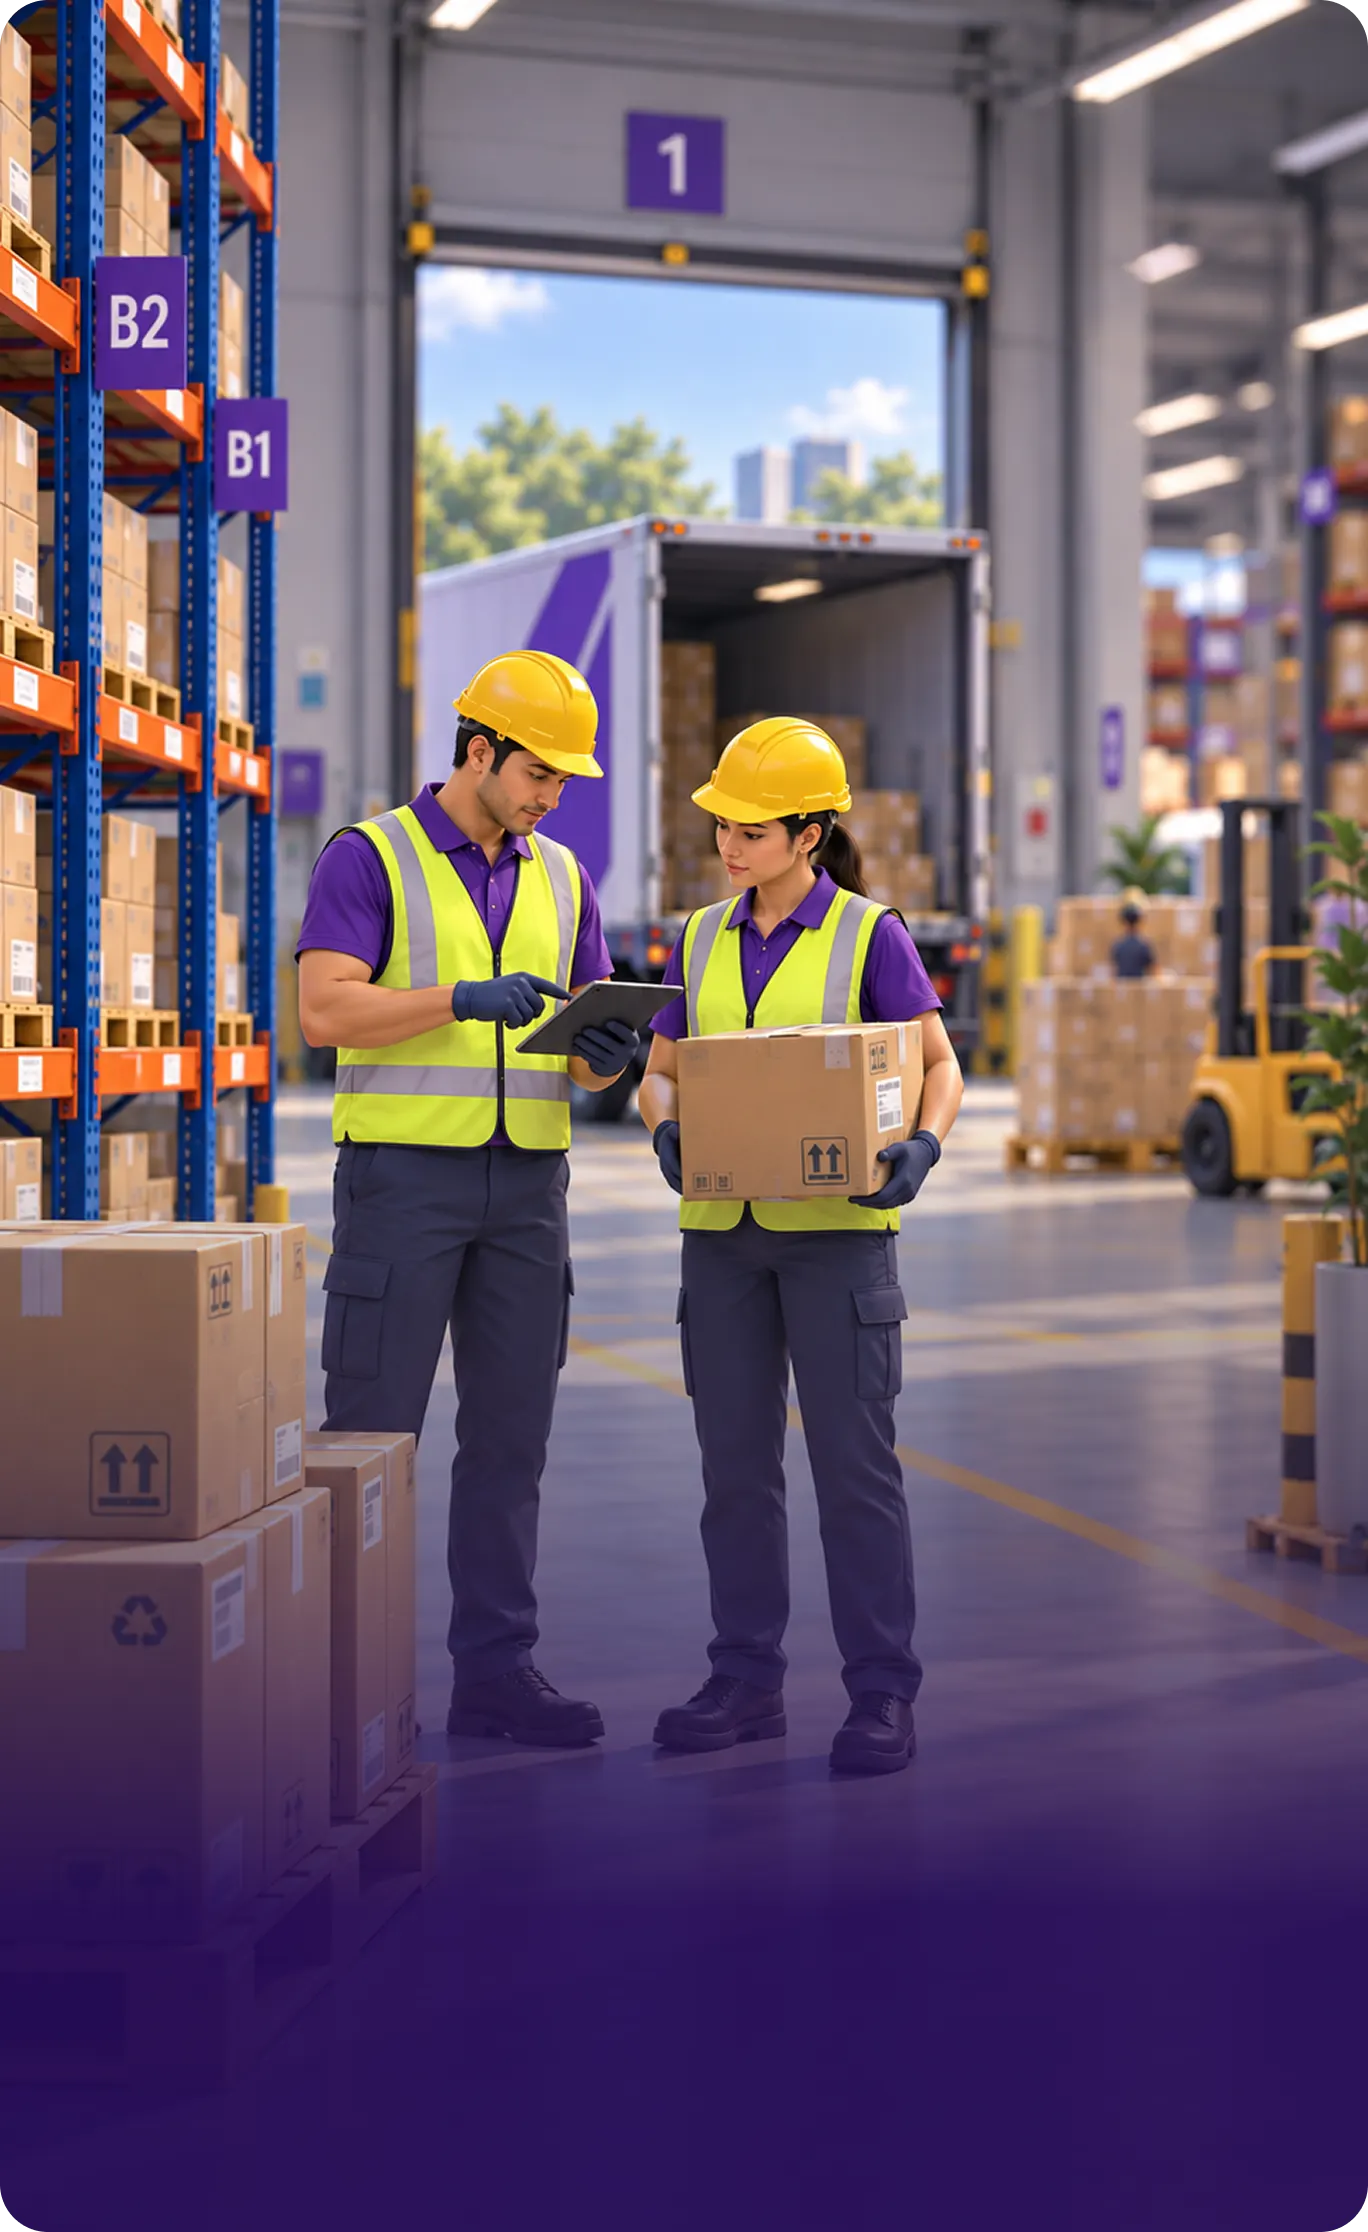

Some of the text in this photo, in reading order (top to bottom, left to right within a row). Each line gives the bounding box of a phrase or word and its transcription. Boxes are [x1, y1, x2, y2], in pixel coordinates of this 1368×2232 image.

[657, 134, 687, 194] 1
[109, 294, 169, 349] B2
[227, 430, 271, 478] B1
